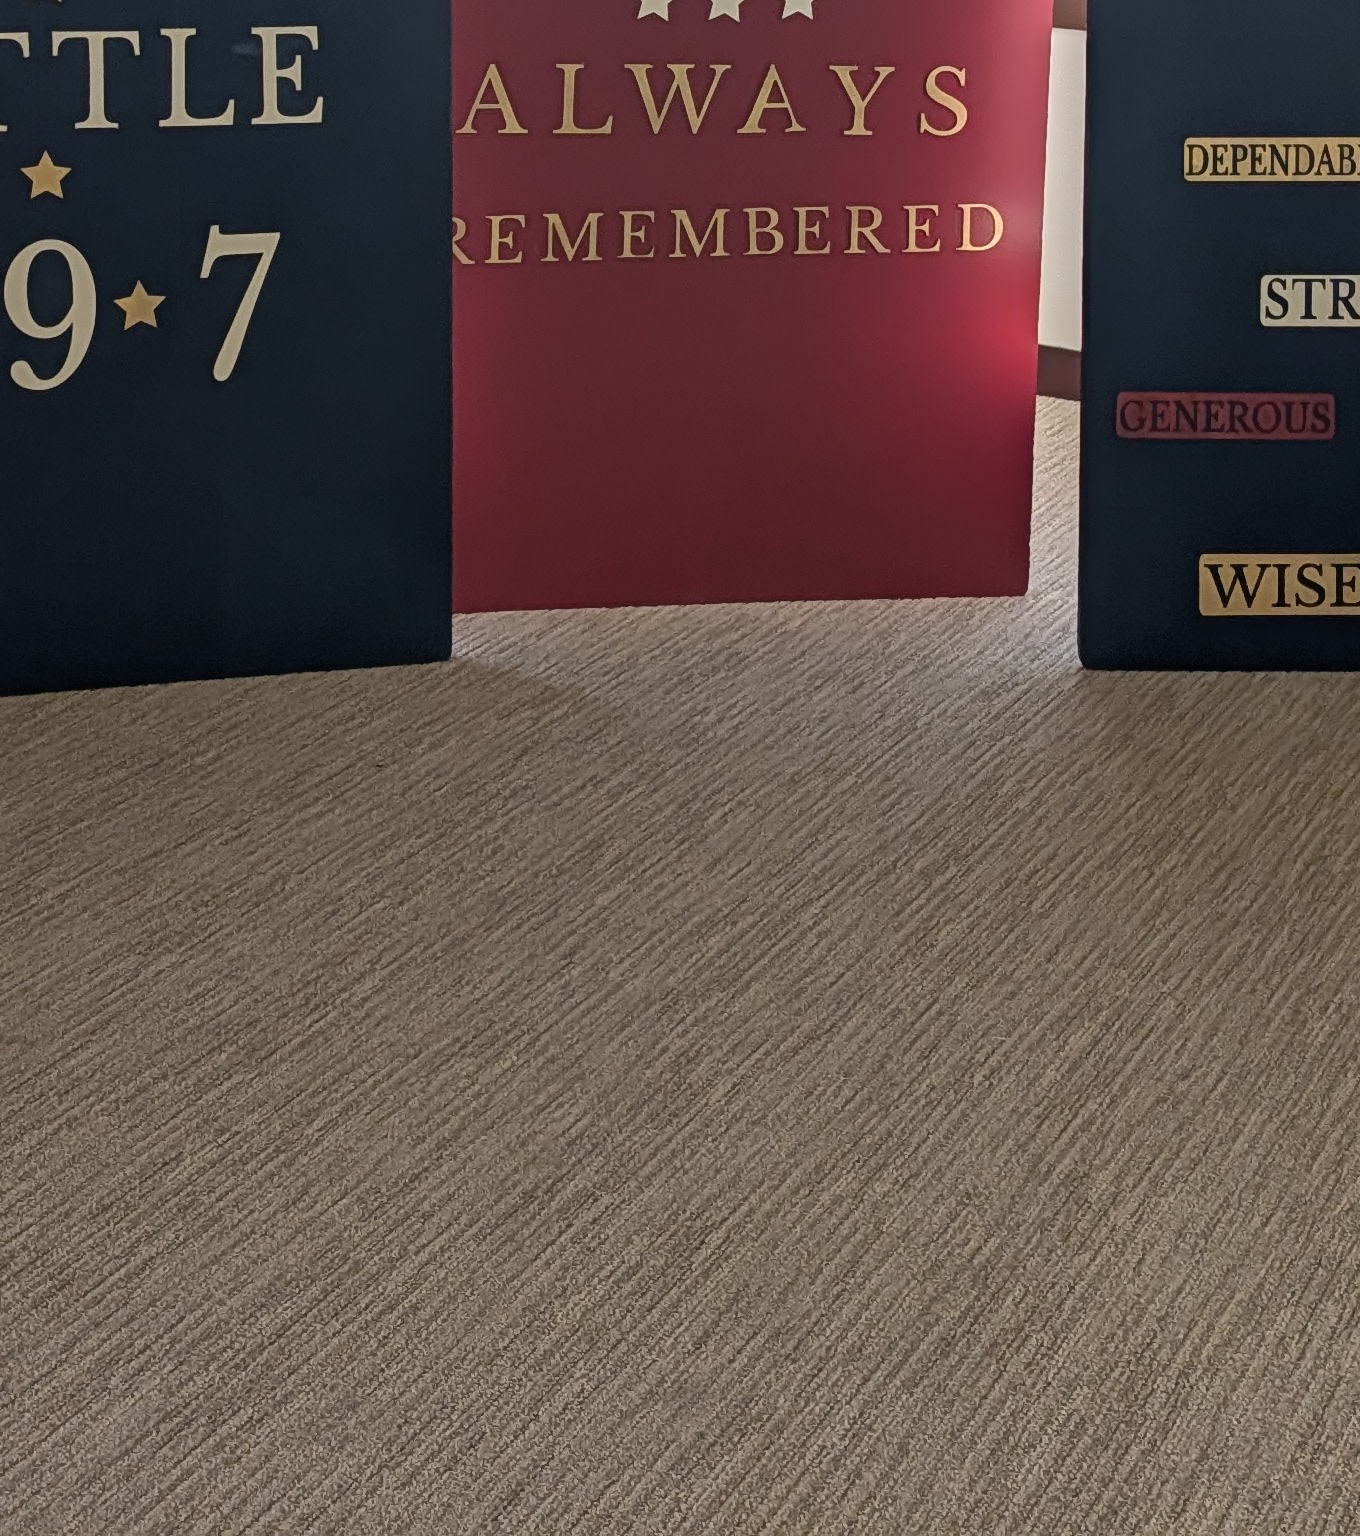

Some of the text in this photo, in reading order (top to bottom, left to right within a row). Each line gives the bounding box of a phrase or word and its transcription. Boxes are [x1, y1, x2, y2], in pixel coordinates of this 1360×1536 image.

[456, 63, 967, 136] ALWAYS
[3, 239, 97, 392] 9
[199, 224, 281, 381] 7
[1120, 400, 1331, 433] GENEROUS
